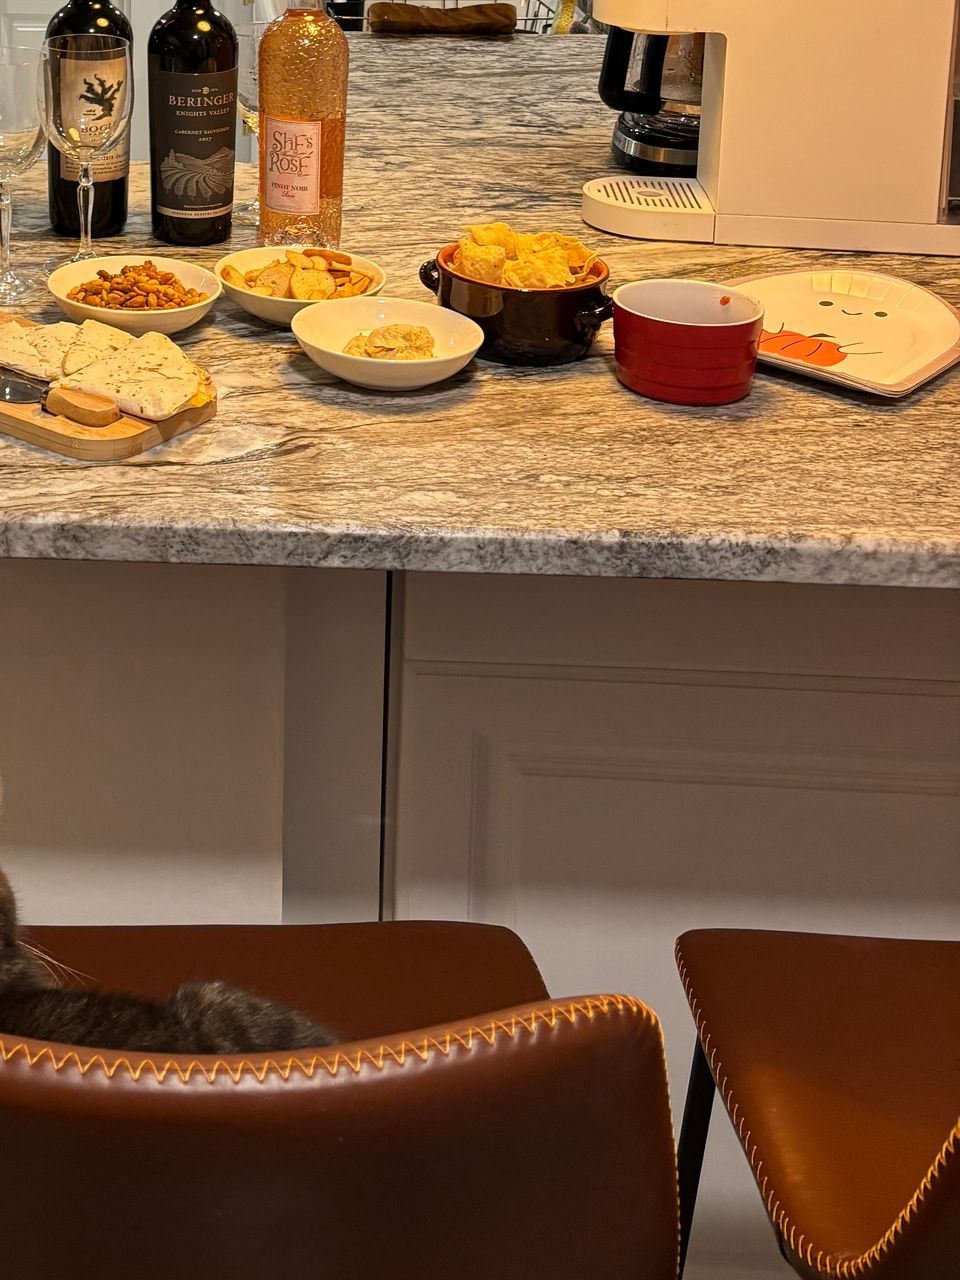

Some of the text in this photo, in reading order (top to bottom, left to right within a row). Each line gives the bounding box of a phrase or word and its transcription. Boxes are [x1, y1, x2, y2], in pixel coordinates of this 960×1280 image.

[168, 92, 234, 108] BERINGER
[208, 107, 230, 116] VALLEY
[271, 181, 290, 190] PINOT
